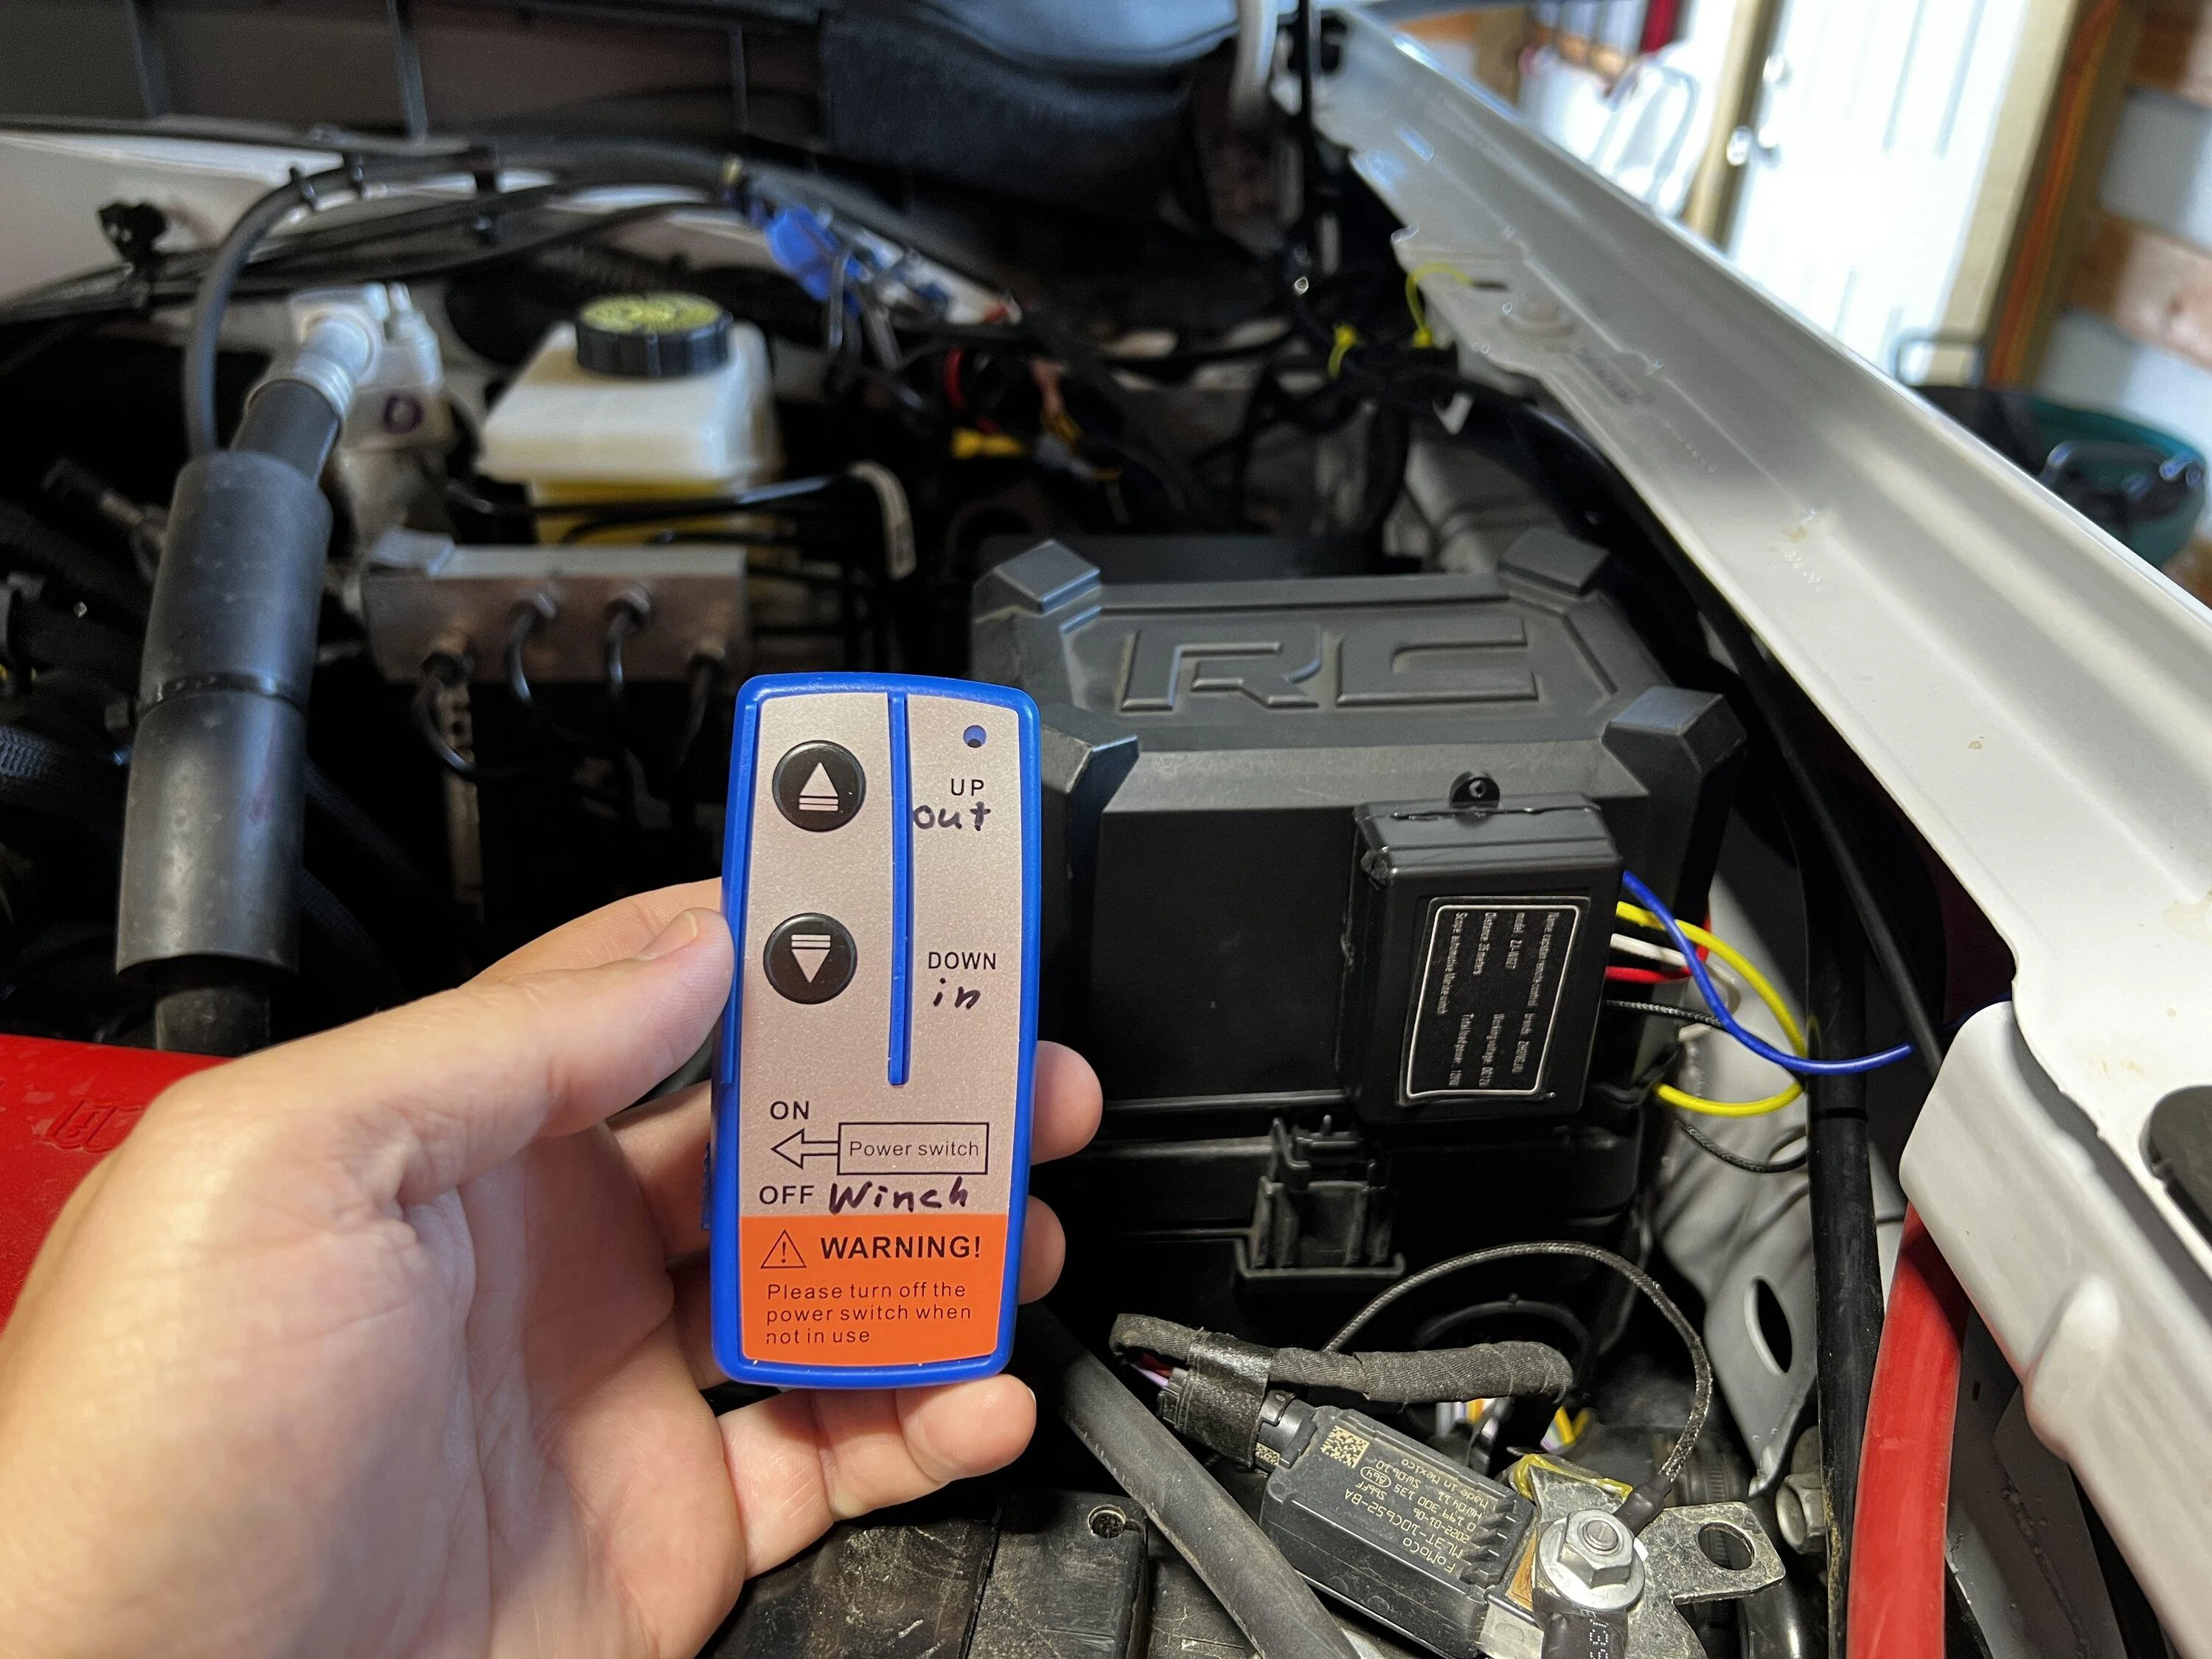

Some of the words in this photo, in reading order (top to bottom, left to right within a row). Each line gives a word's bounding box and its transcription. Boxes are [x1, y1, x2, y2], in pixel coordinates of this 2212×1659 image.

[1121, 616, 1540, 712] RC
[950, 779, 985, 796] UP
[913, 801, 992, 831] out
[928, 951, 997, 970] DOWN
[933, 978, 981, 1009] in
[770, 1100, 810, 1120] ON
[849, 1141, 912, 1157] Power
[917, 1140, 980, 1157] switch
[759, 1185, 814, 1205] OFF
[829, 1176, 969, 1214] Winch
[819, 1235, 981, 1260] WARNING!
[767, 1283, 843, 1301] Please
[850, 1284, 892, 1299] turn
[900, 1281, 928, 1298] off
[933, 1281, 966, 1298] the
[766, 1307, 834, 1326] power
[840, 1305, 908, 1321] switch
[917, 1304, 972, 1320] when
[766, 1329, 800, 1345] not
[807, 1328, 825, 1343] in
[832, 1329, 871, 1343] use
[1399, 1456, 1441, 1485] Mexico
[1392, 1482, 1416, 1500] 135
[1441, 1478, 1457, 1492] in
[1416, 1495, 1440, 1513] 300
[1458, 1487, 1489, 1509] Made
[1410, 1506, 1470, 1545] 2022-01-06
[1441, 1508, 1465, 1526] 199
[1399, 1535, 1457, 1573] FoMoCo
